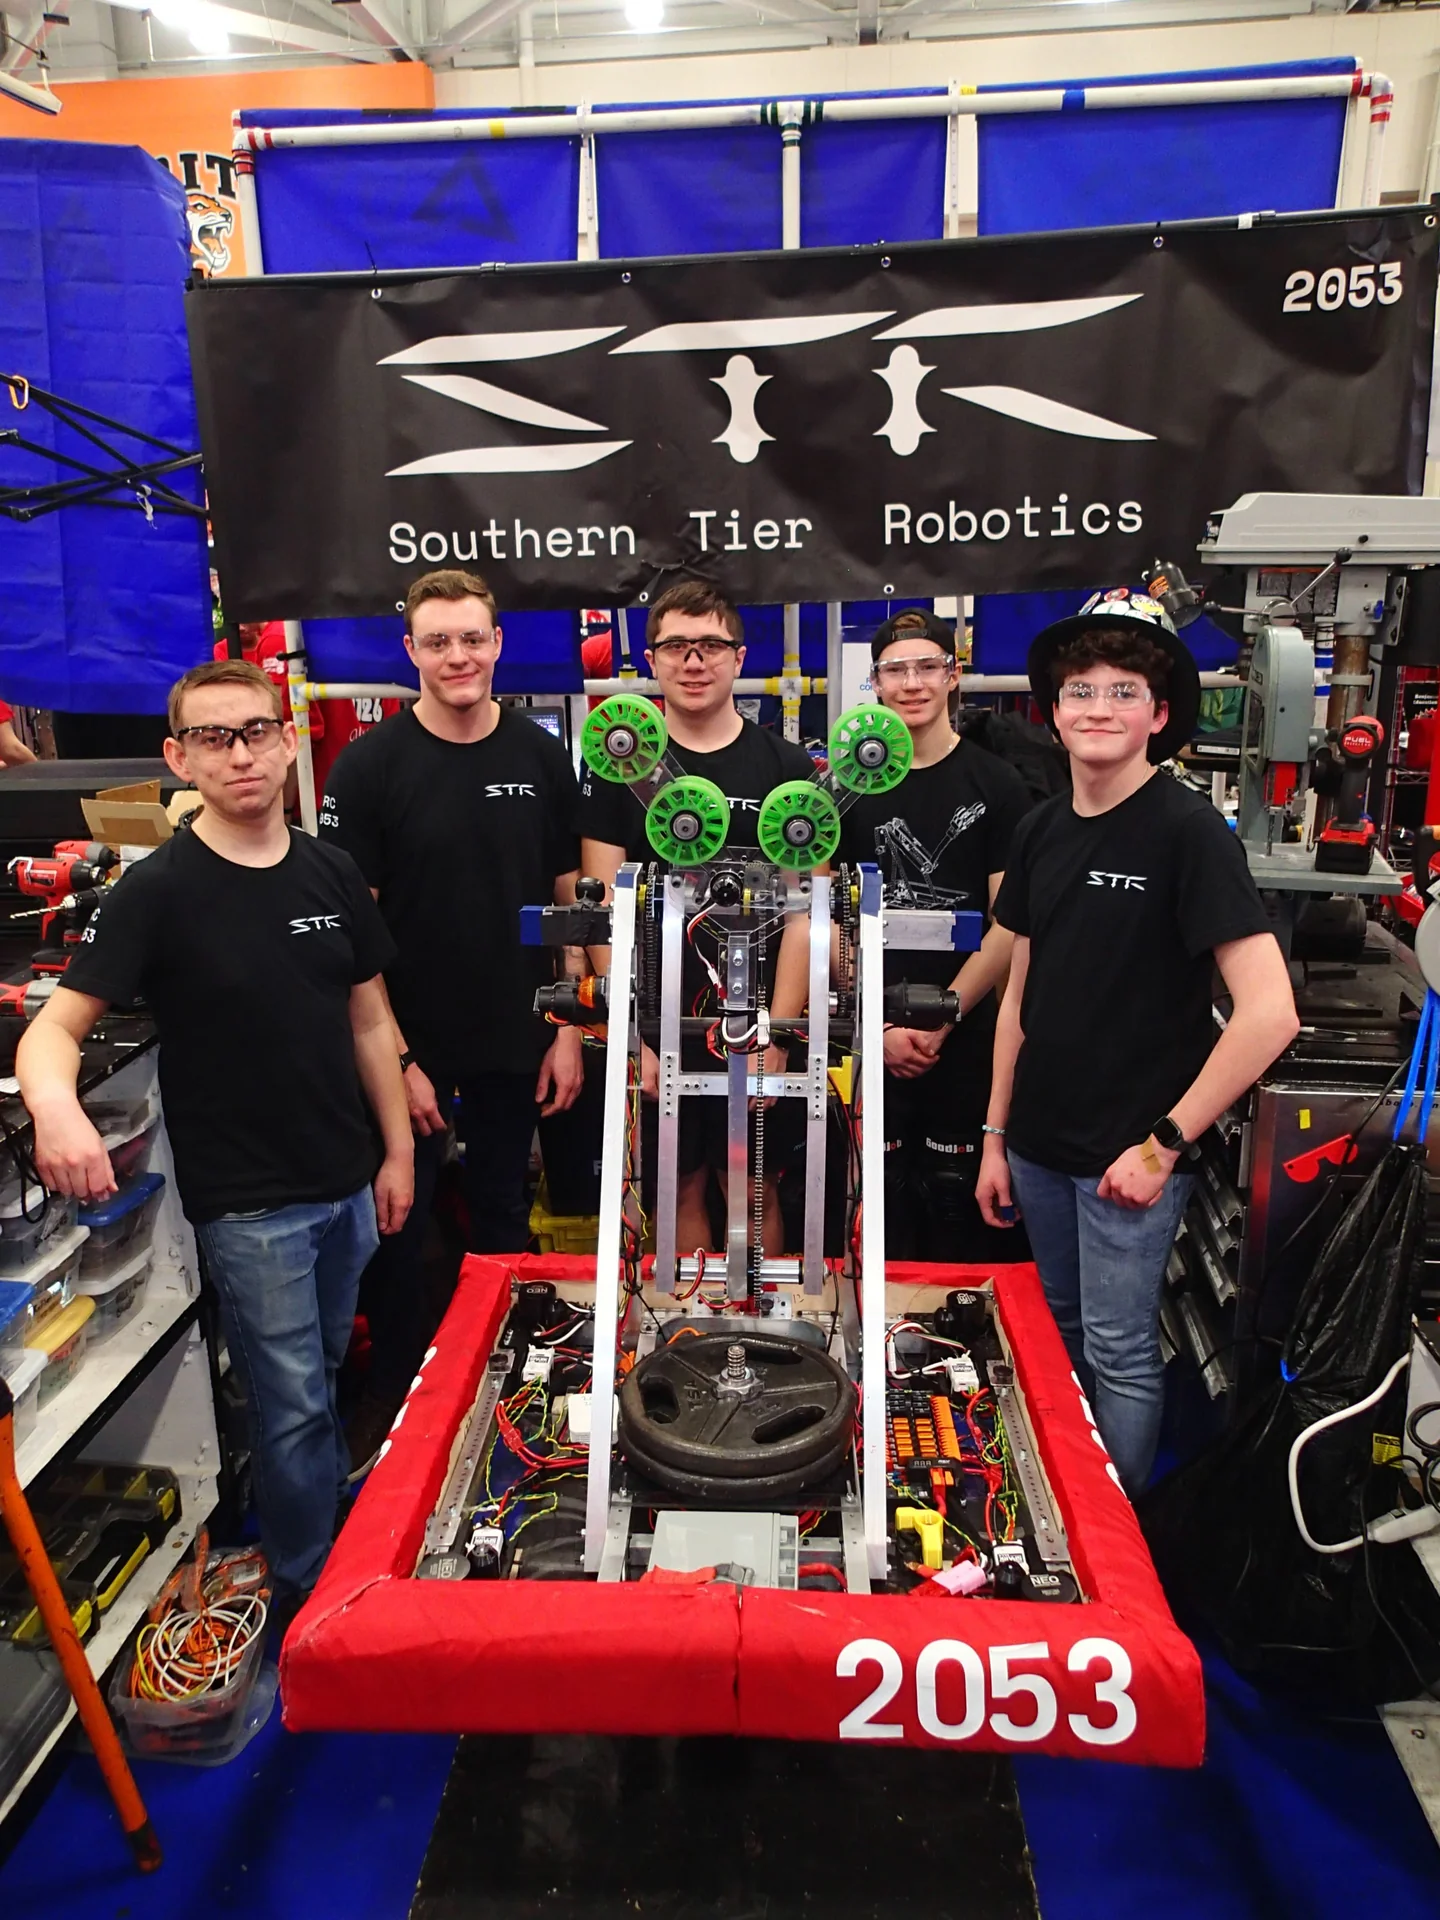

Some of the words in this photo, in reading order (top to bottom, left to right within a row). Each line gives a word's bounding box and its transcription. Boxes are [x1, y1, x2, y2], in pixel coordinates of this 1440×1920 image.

[156, 153, 236, 200] IT
[1282, 261, 1403, 312] 2053
[388, 519, 636, 564] Southern
[689, 509, 813, 552] Tier
[884, 493, 1143, 545] Robotics
[1030, 1574, 1060, 1588] NEO
[835, 1637, 1137, 1745] 2053
